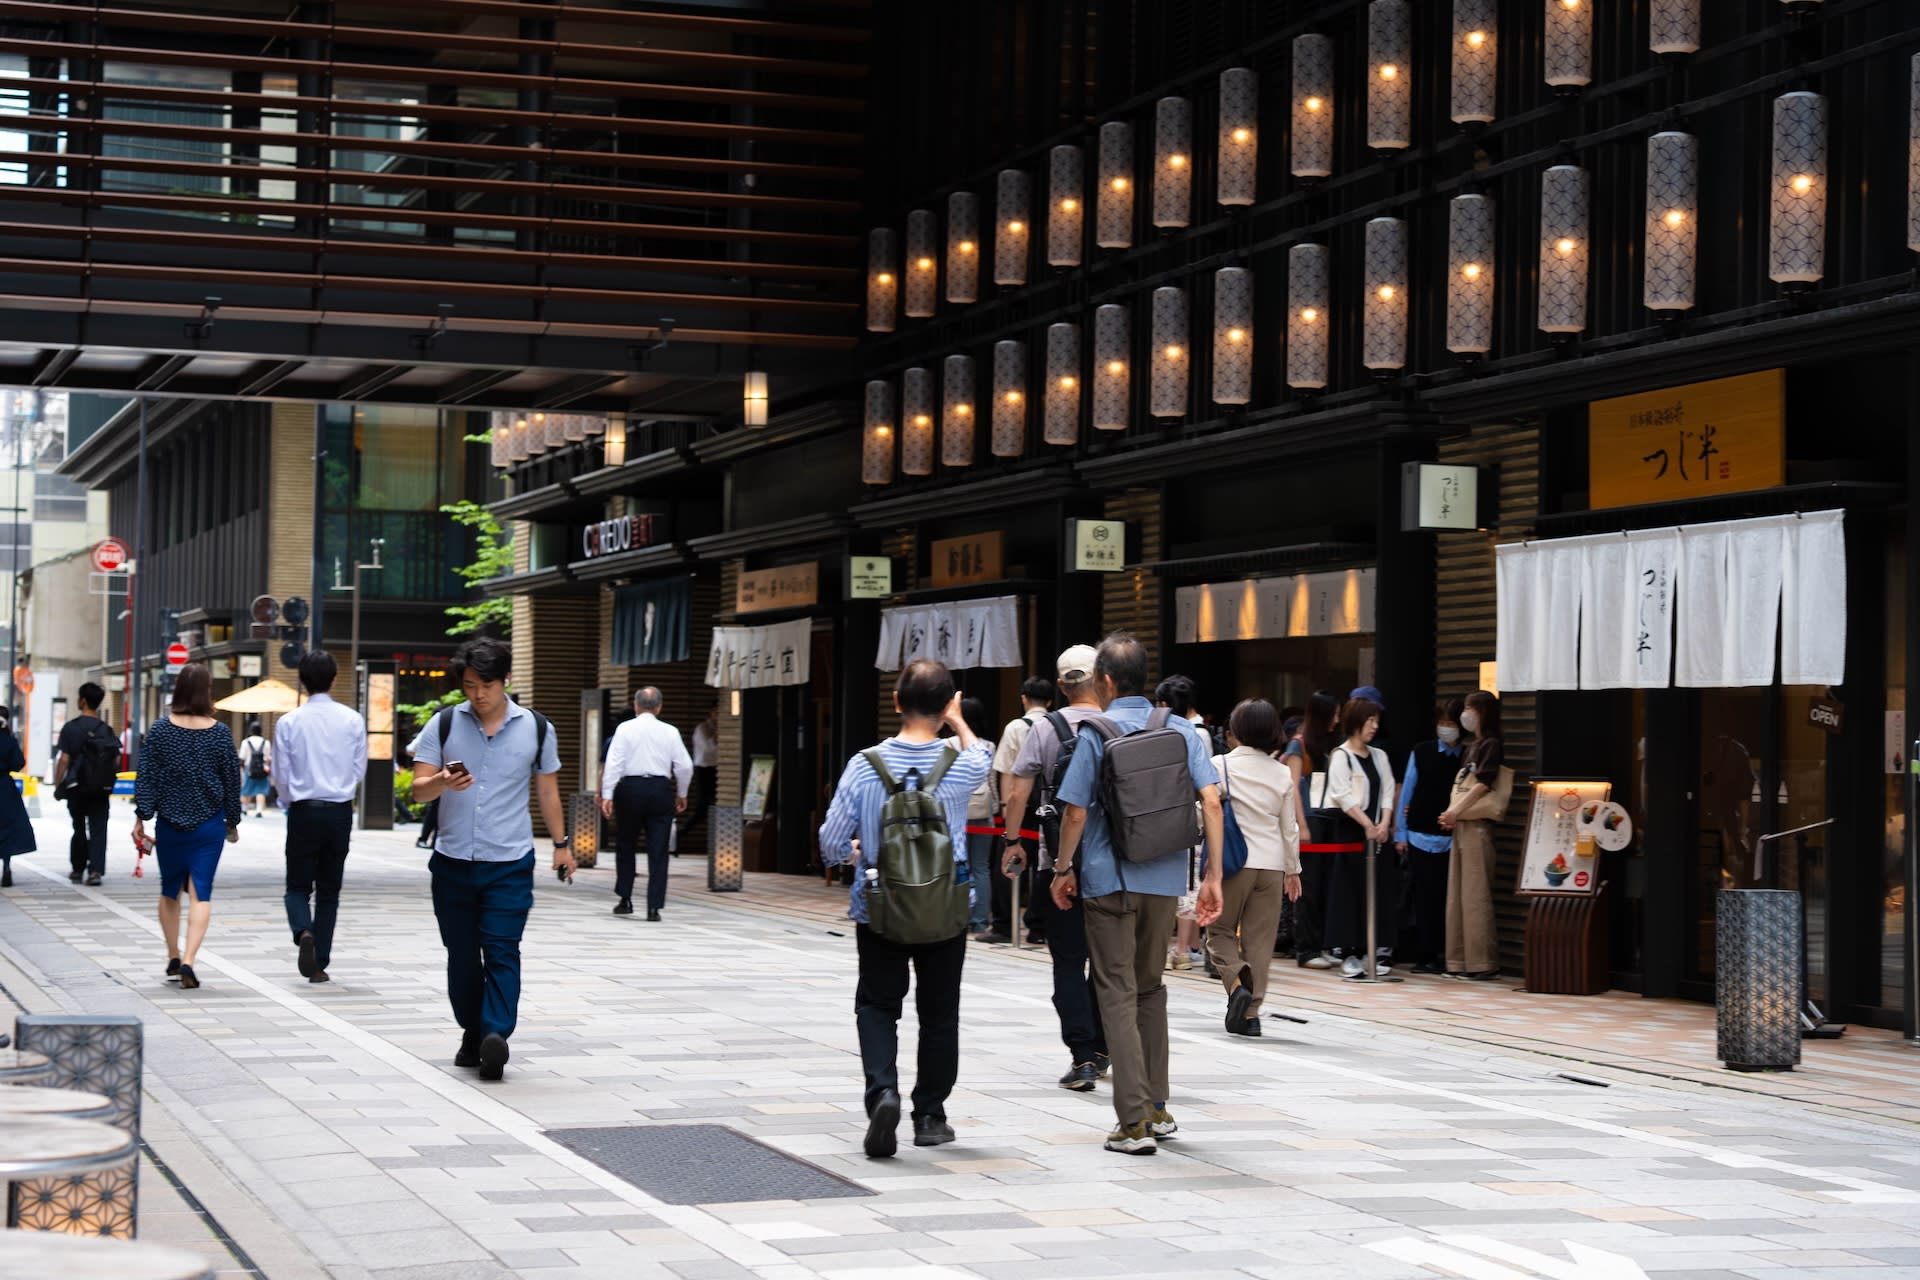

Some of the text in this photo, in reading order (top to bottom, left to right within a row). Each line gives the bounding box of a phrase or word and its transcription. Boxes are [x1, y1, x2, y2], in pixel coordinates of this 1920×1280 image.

[1641, 423, 1719, 481] つじ半
[1635, 568, 1656, 665] つじ半
[1809, 707, 1840, 728] OPEN
